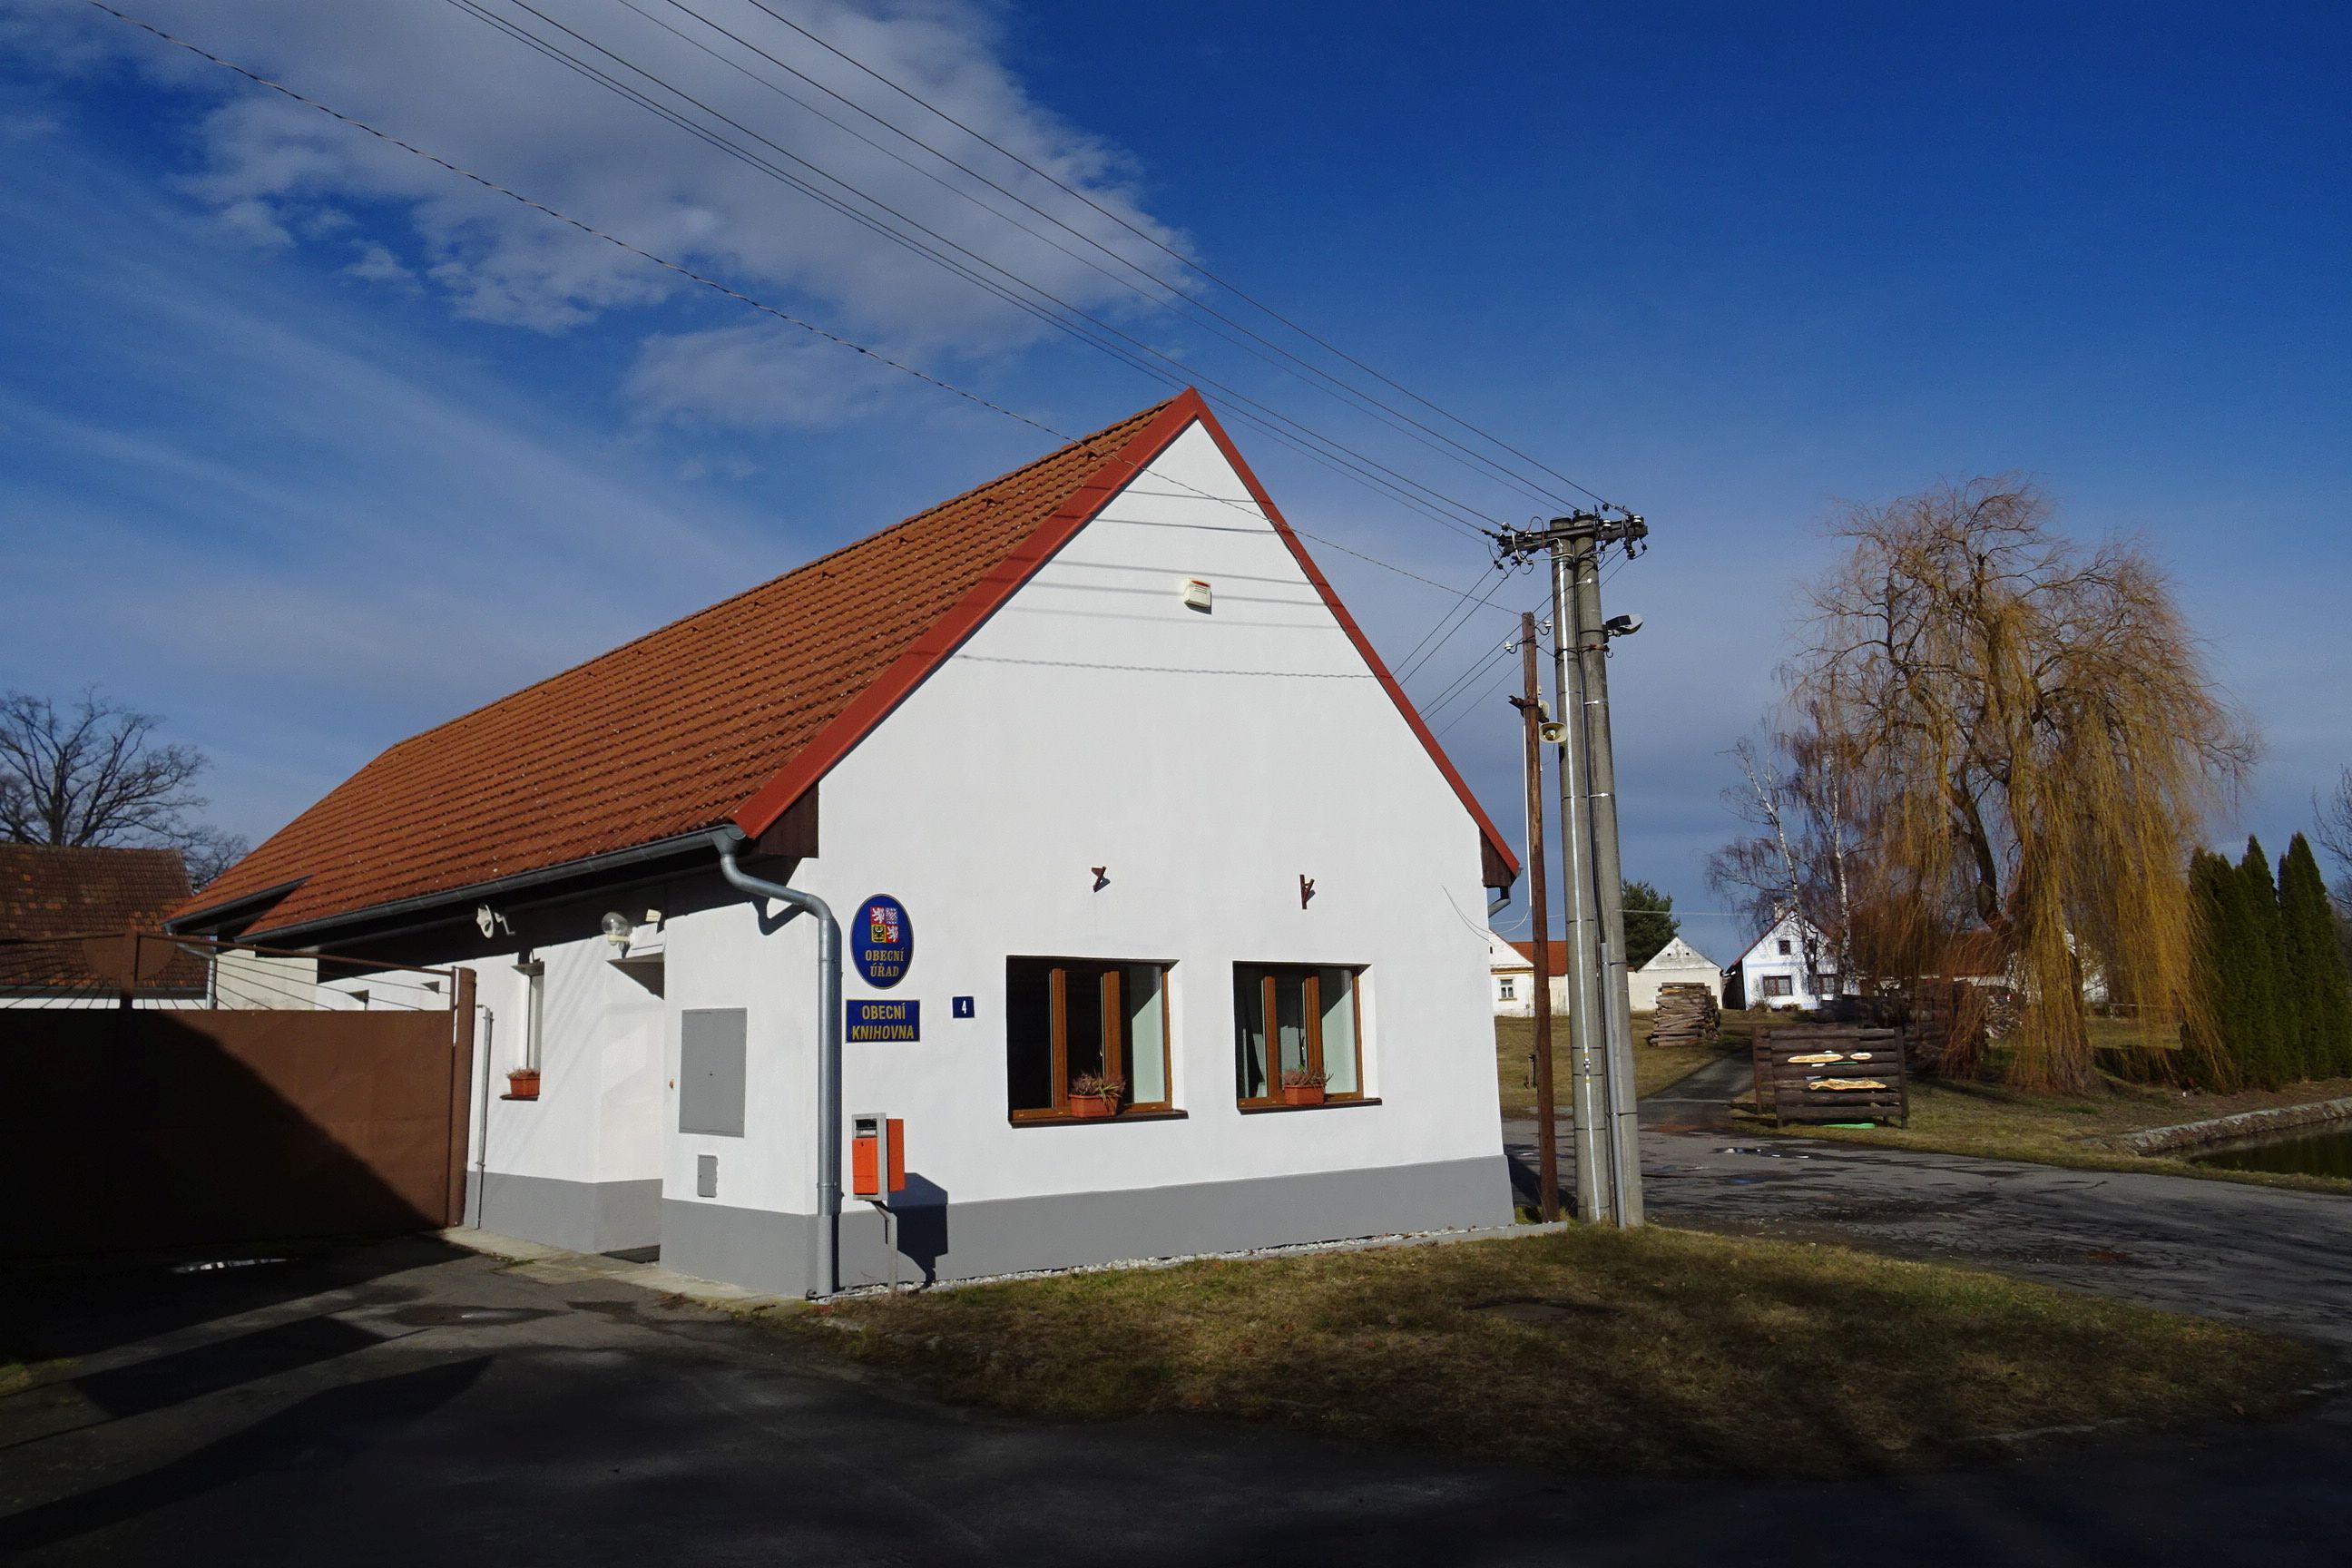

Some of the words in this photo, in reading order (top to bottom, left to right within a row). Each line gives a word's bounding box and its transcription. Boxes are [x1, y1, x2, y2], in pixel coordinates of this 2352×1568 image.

[865, 946, 905, 962] OBECNÍ
[870, 963, 899, 977] ÚŘAD
[862, 1003, 906, 1020] OBECNÍ
[961, 1000, 967, 1014] 4
[852, 1025, 915, 1040] KNIHOVNA
